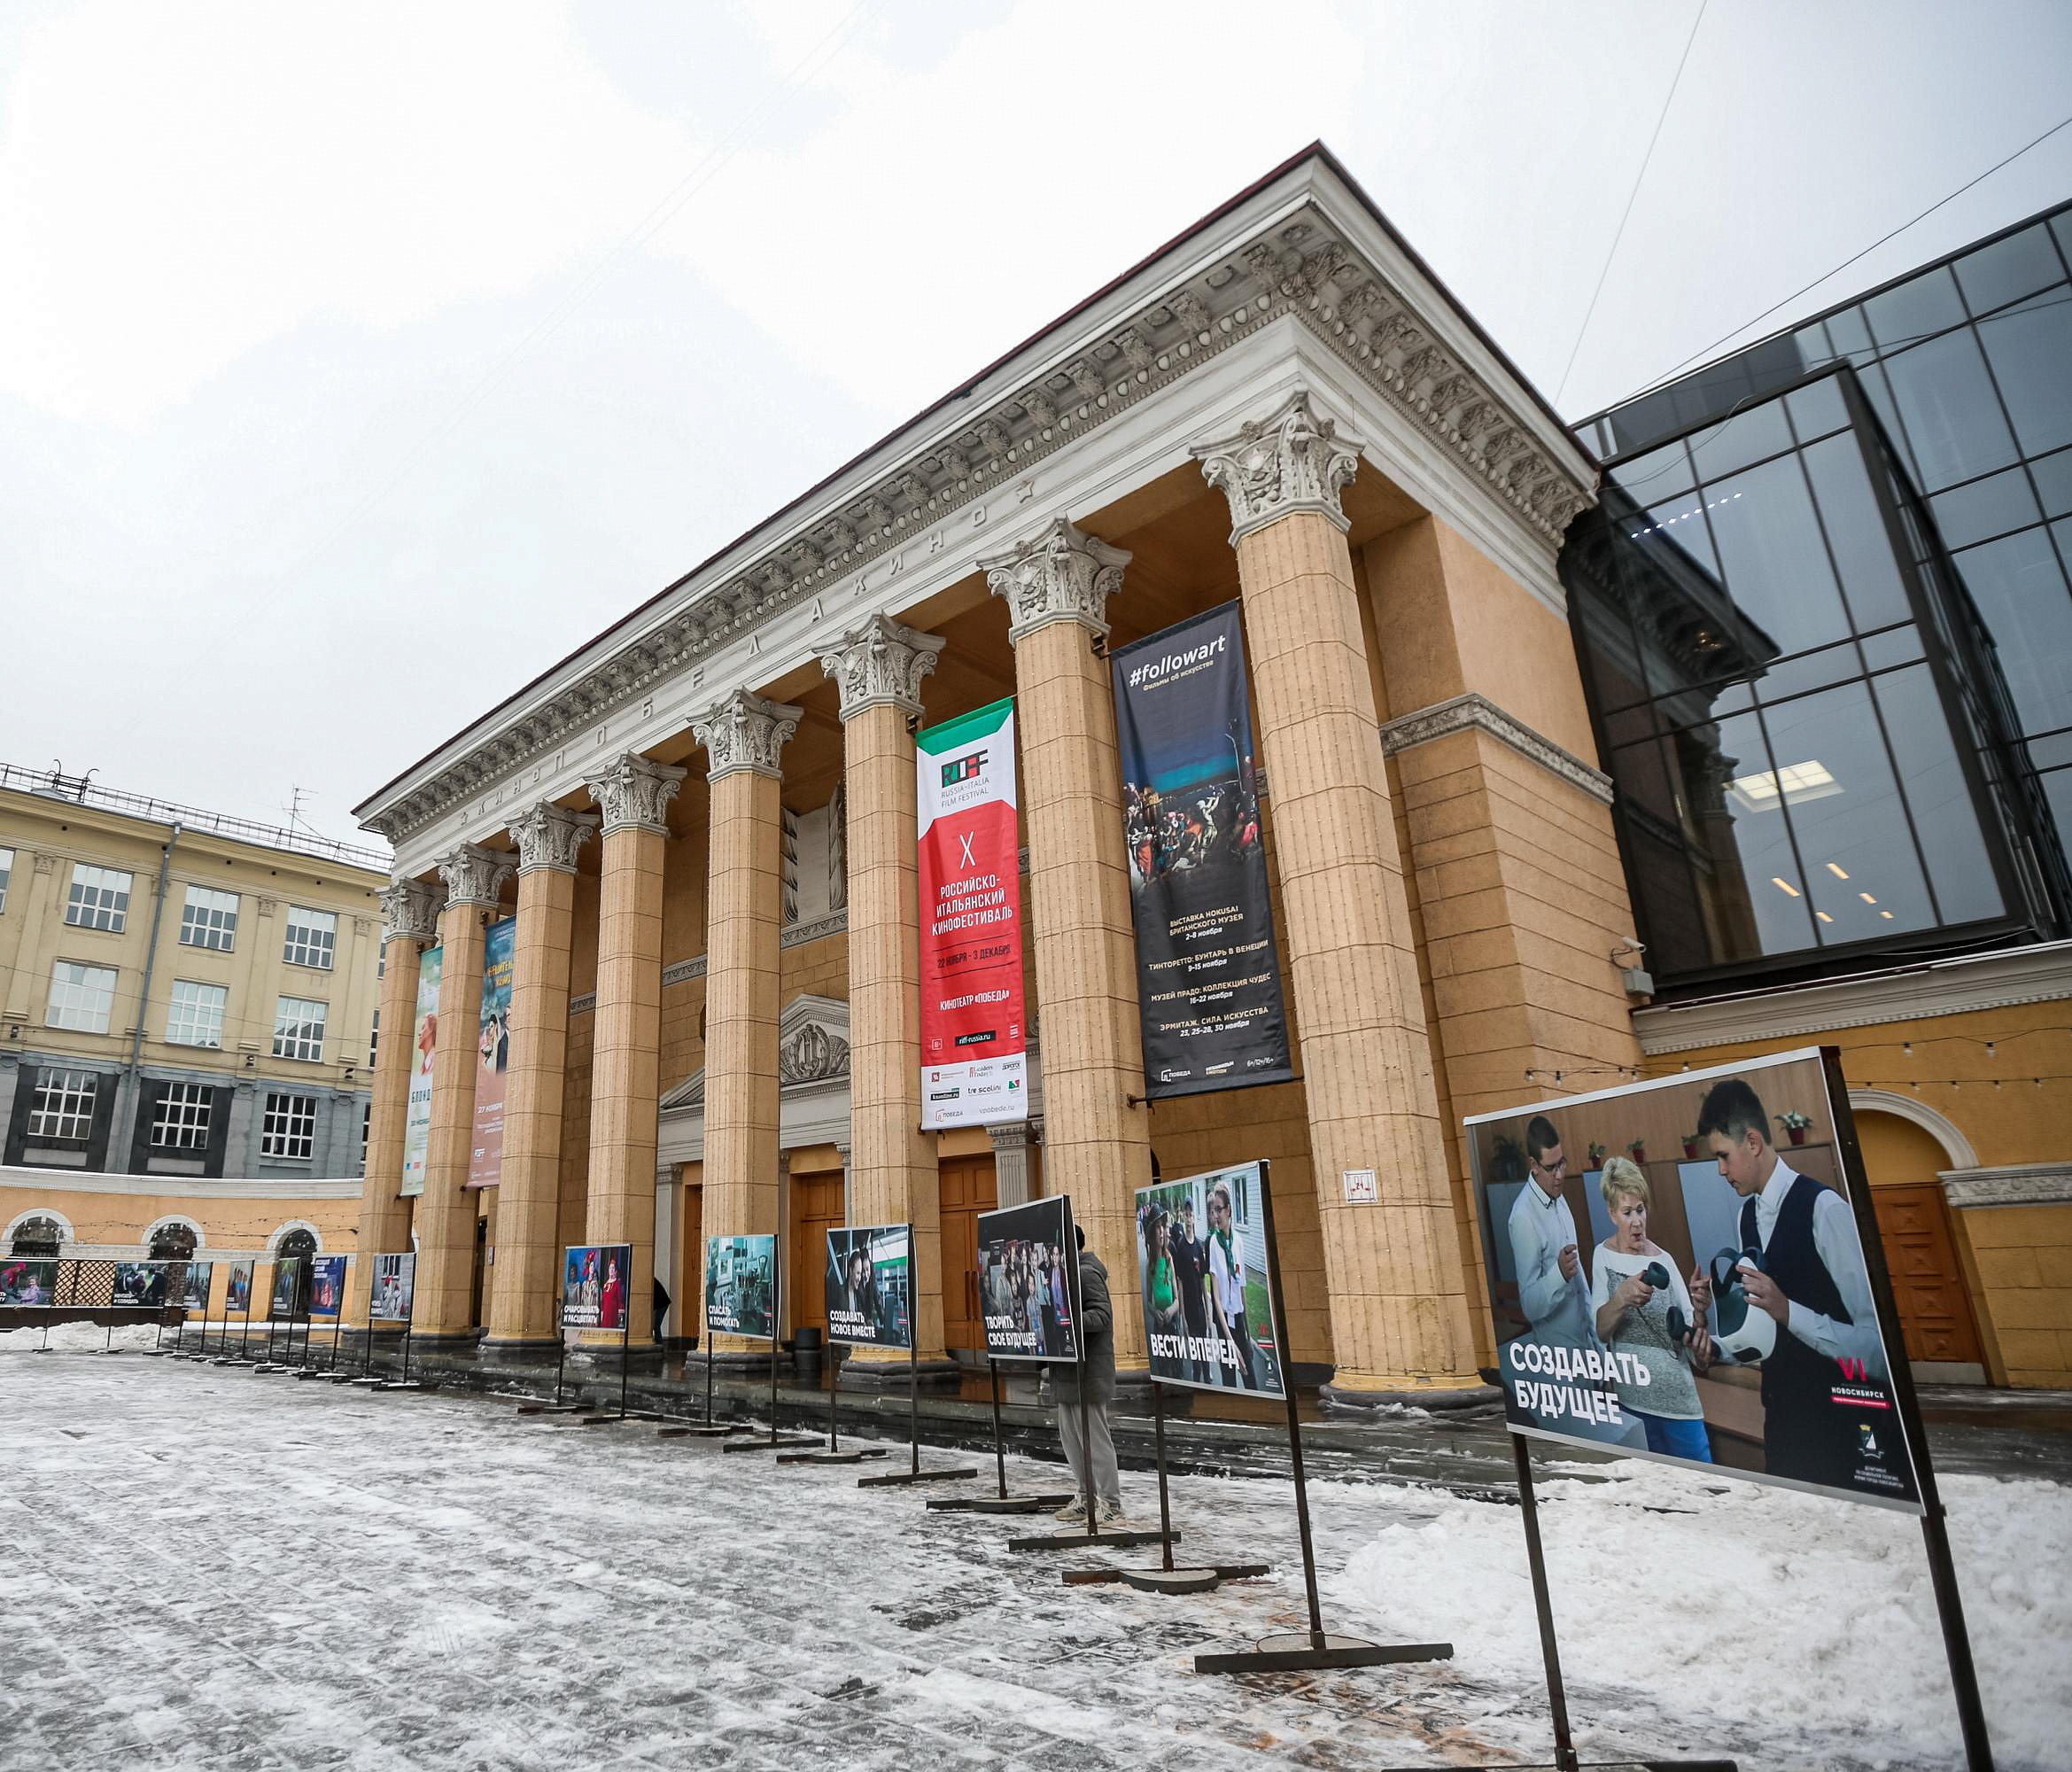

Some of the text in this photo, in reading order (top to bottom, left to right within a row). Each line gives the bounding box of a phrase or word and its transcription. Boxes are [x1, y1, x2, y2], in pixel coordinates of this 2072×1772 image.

[1129, 634, 1226, 687] #followart
[942, 787, 989, 808] FILM FESTIVAL
[940, 874, 1001, 899] РОССИЙСКО-
[936, 887, 1005, 918] ИТАЛЬЯНСКИЙ
[932, 905, 1013, 937] КИНОФЕСТИВАЛЬ
[1169, 905, 1238, 928] ВЫСТАВКА HOKUSAI
[1169, 913, 1244, 937] БРИТАНСКОГО МУЗЕЯ
[1198, 926, 1222, 937] ноября
[980, 944, 1012, 960] ДЕКАБРЯ
[1148, 956, 1194, 971] ТИНТОРЕТТО:
[1195, 949, 1227, 961] БУНТАРЬ
[1236, 939, 1269, 953] ВЕНЕЦИИ
[1202, 958, 1228, 969] ноября
[1152, 972, 1271, 1002] МУЗЕЙ ПРАДО: КОЛЛЕКЦИЯ ЧУДЕС
[1207, 991, 1233, 1001] ноября
[940, 990, 1010, 1011] КИНОТЕАТР «ПОБЕДА»
[1201, 1015, 1222, 1025] СИЛА
[1223, 1006, 1269, 1022] ИСКУССТВА
[1224, 1019, 1250, 1030] ноября
[830, 1310, 865, 1323] СОЗДАВАТЬ
[985, 1316, 1014, 1329] ТВОРИТЬ
[830, 1324, 875, 1338] НОВОЕ ВМЕСТЕ
[989, 1332, 1037, 1348] СВОЕ БУДУЩЕЕ
[1151, 1334, 1240, 1369] ВЕСТИ ВПЕРЕД
[1509, 1342, 1651, 1387] СОЗДАВАТЬ
[1515, 1380, 1624, 1426] БУДУЩЕЕ
[1831, 1387, 1885, 1399] НОВОСИБИРСК
